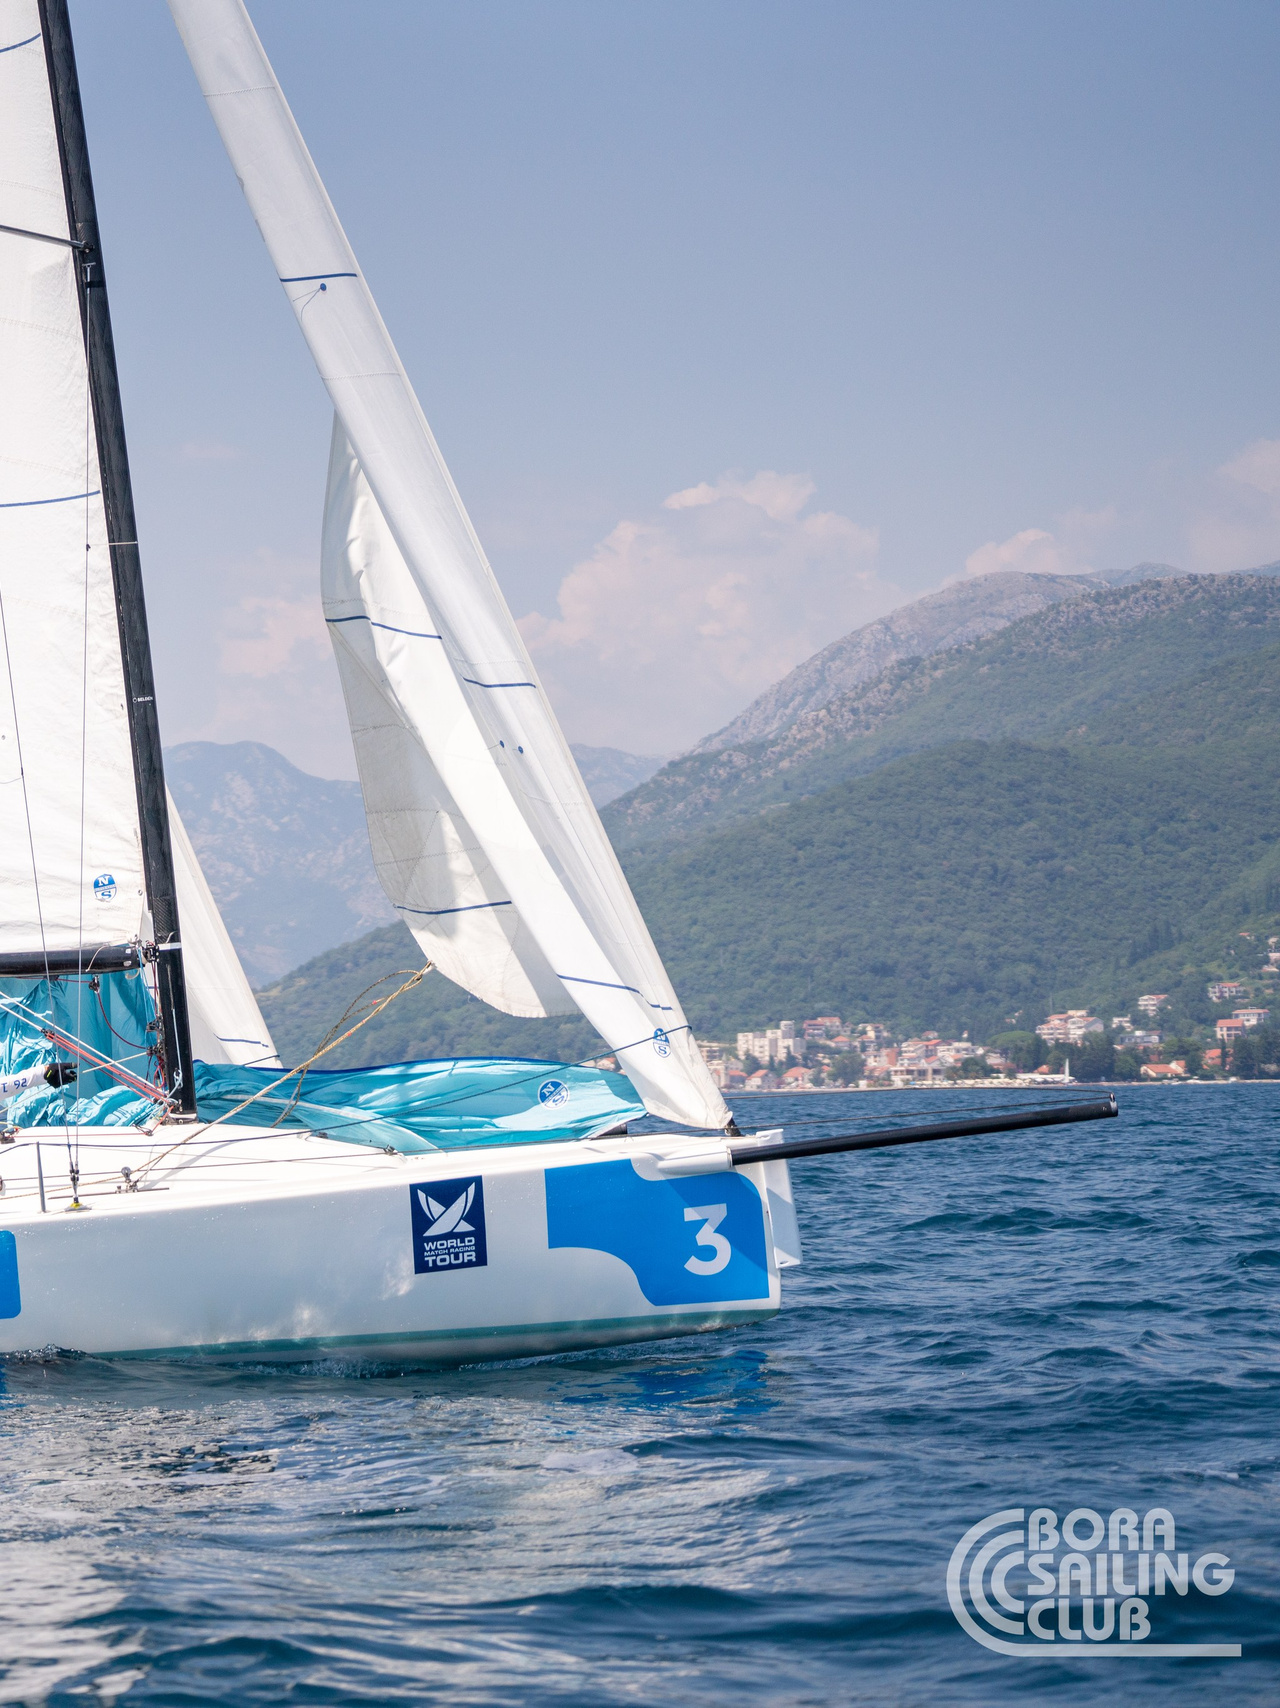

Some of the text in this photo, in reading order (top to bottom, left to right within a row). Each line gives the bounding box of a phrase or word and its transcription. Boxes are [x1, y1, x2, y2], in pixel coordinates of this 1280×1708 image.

[658, 1046, 667, 1055] S
[541, 1082, 555, 1097] N
[552, 1092, 565, 1106] S
[423, 1236, 475, 1251] WORLD
[683, 1203, 732, 1276] 3
[424, 1245, 475, 1256] MATCH RACING
[424, 1251, 476, 1267] TOUR
